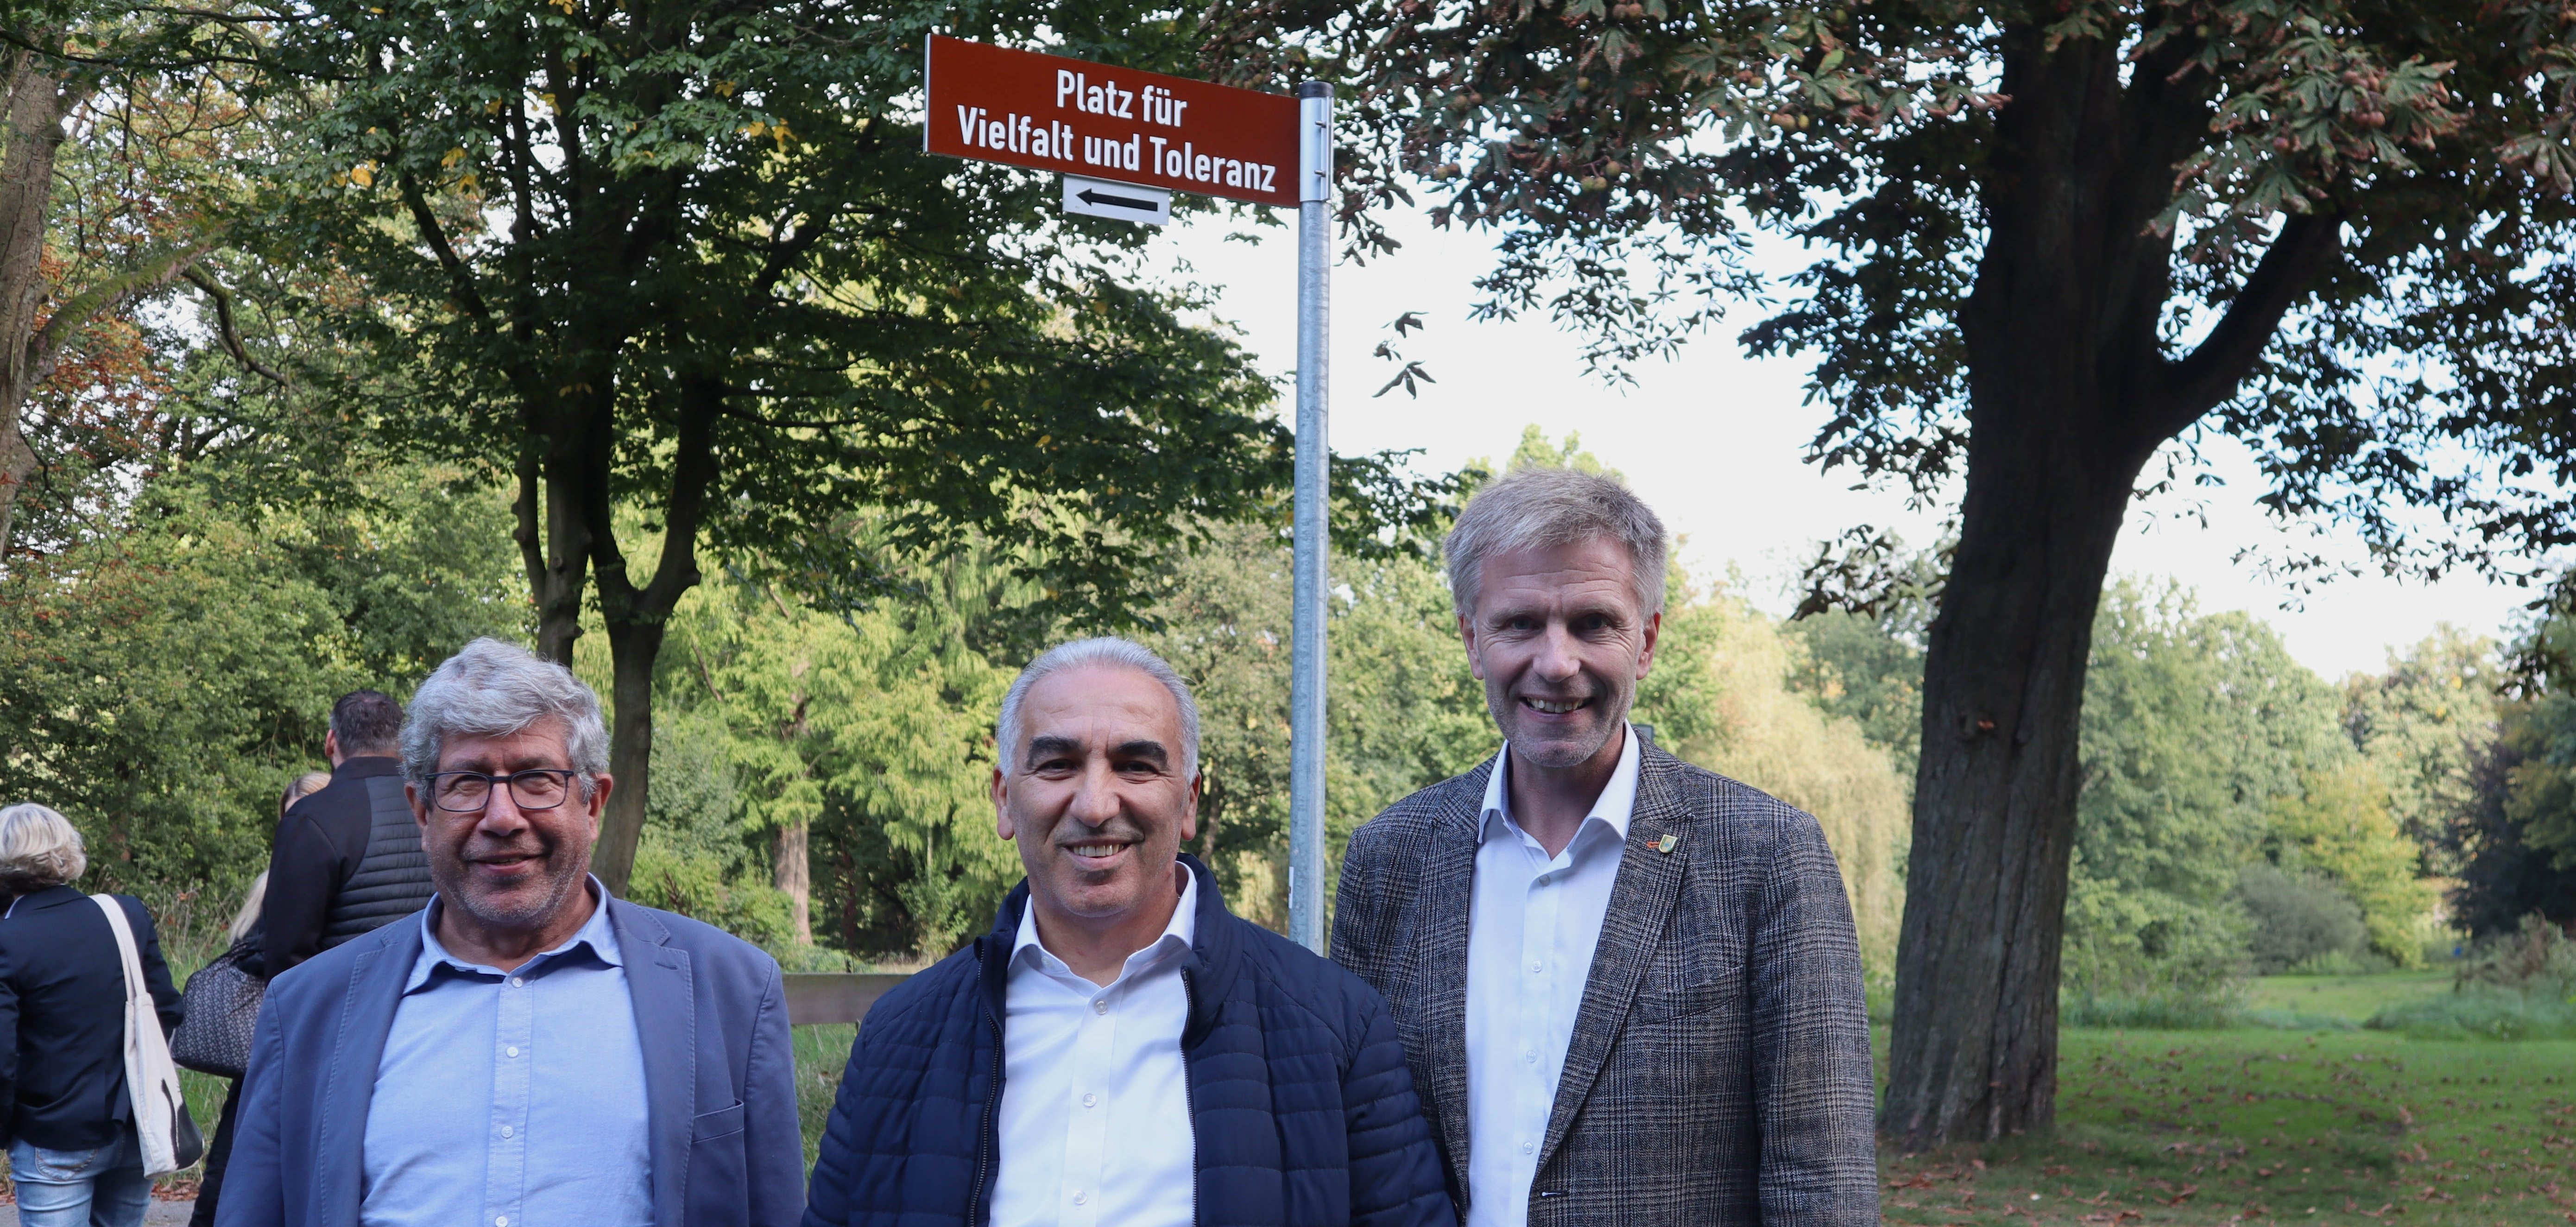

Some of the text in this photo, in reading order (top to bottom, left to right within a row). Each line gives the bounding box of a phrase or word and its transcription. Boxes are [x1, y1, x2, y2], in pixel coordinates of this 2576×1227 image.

[1057, 69, 1187, 127] Platz für
[957, 104, 1276, 193] Vielfalt und Toleranz
